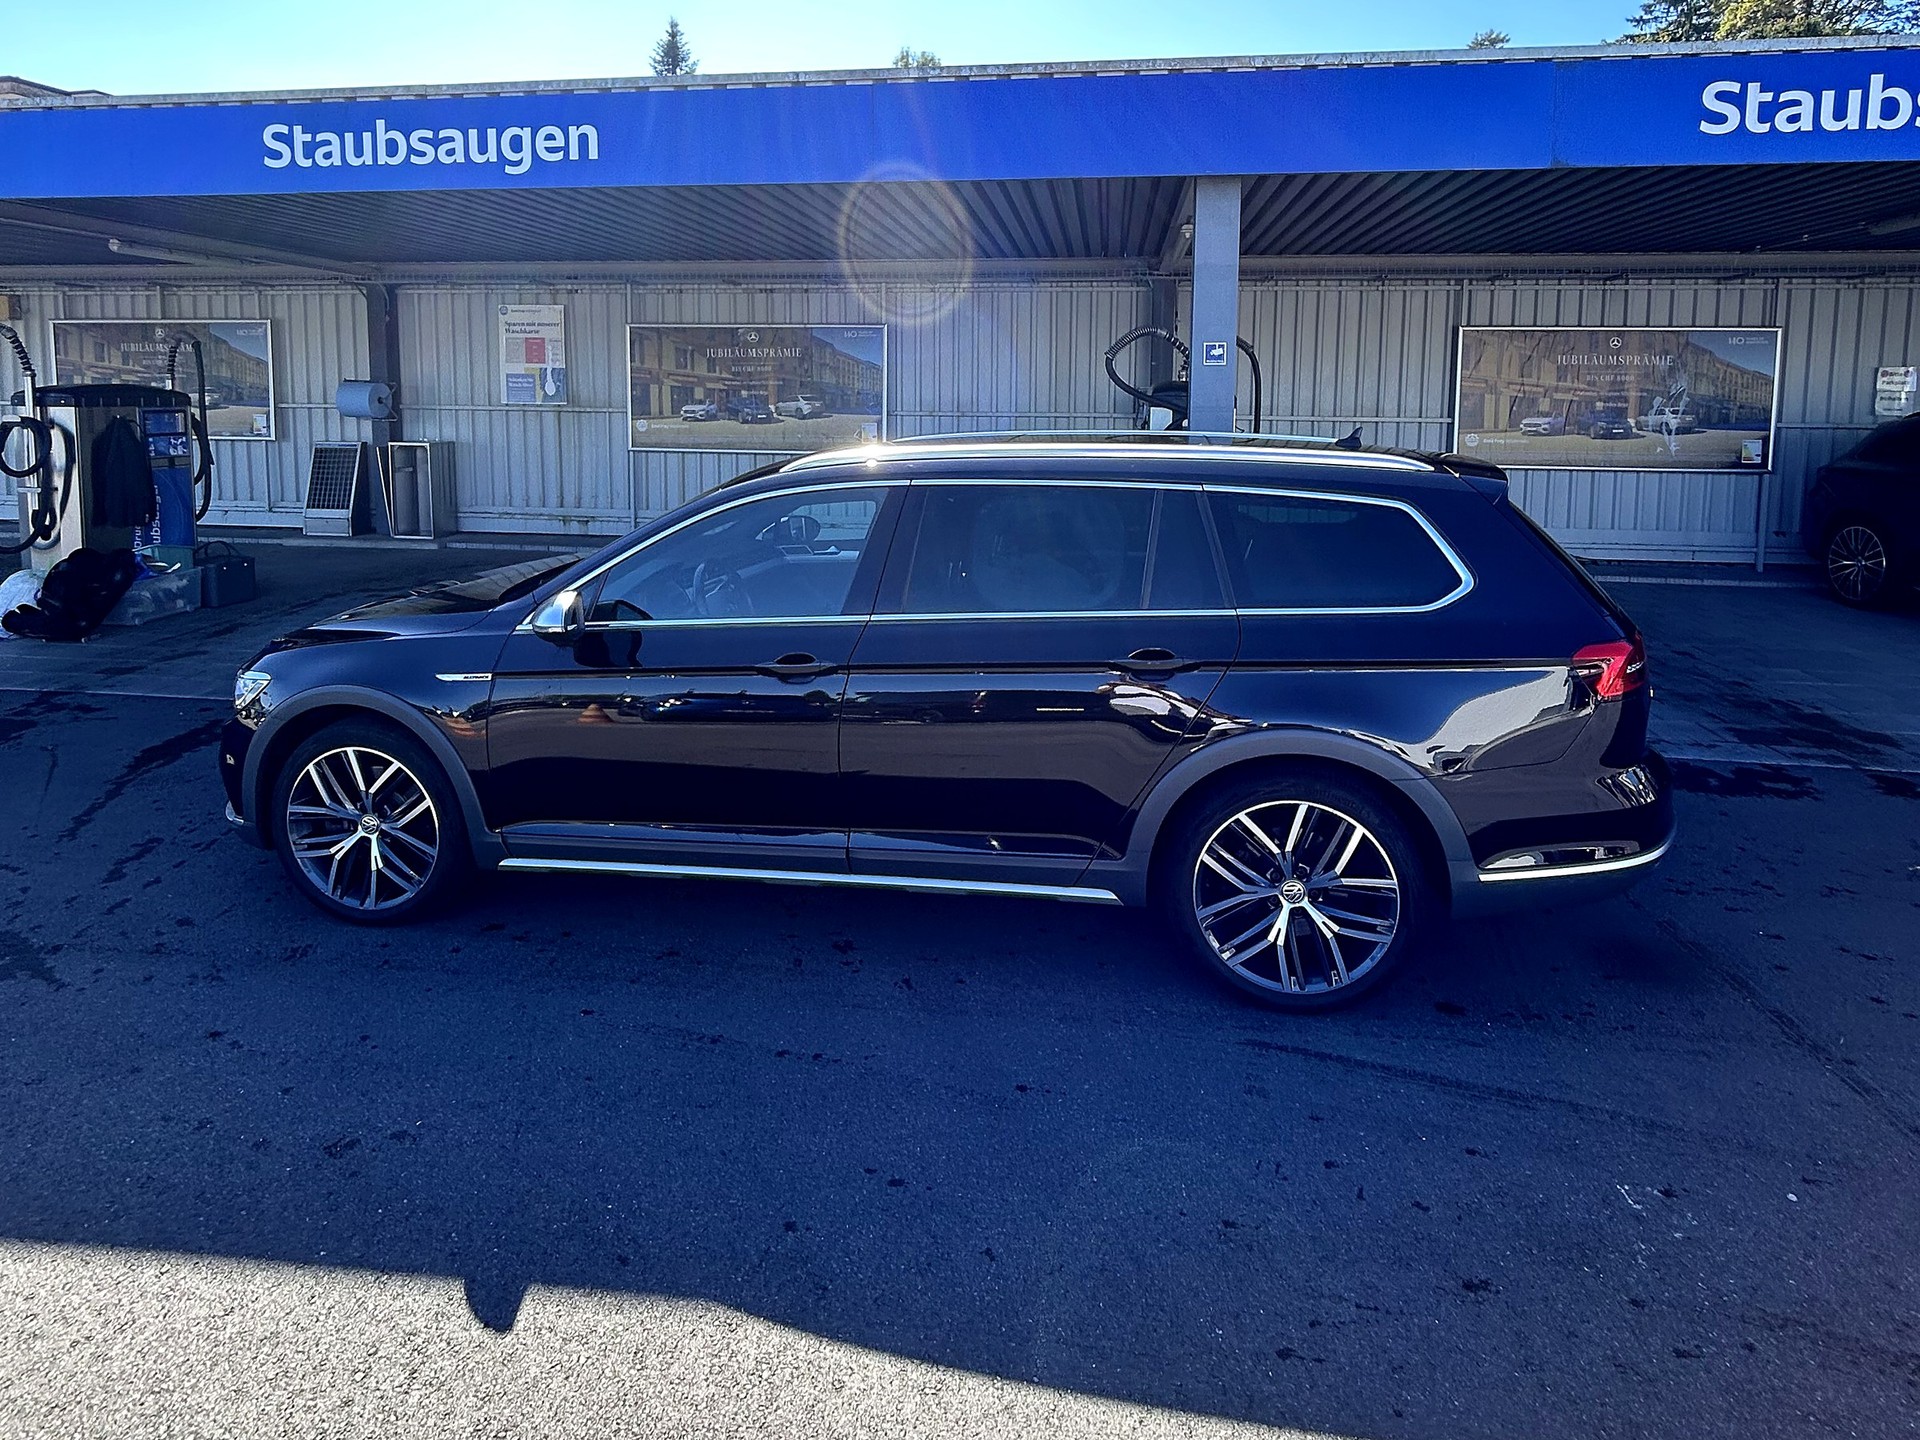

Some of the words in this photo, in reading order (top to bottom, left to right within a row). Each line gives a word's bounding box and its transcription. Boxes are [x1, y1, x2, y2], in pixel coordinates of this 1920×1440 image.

[1700, 74, 1920, 135] Staub
[263, 119, 598, 175] Staubsaugen
[706, 346, 802, 358] JUBILÄUMSPRÄMIE
[1557, 353, 1674, 366] JUBILÄUMSPRÄMIE
